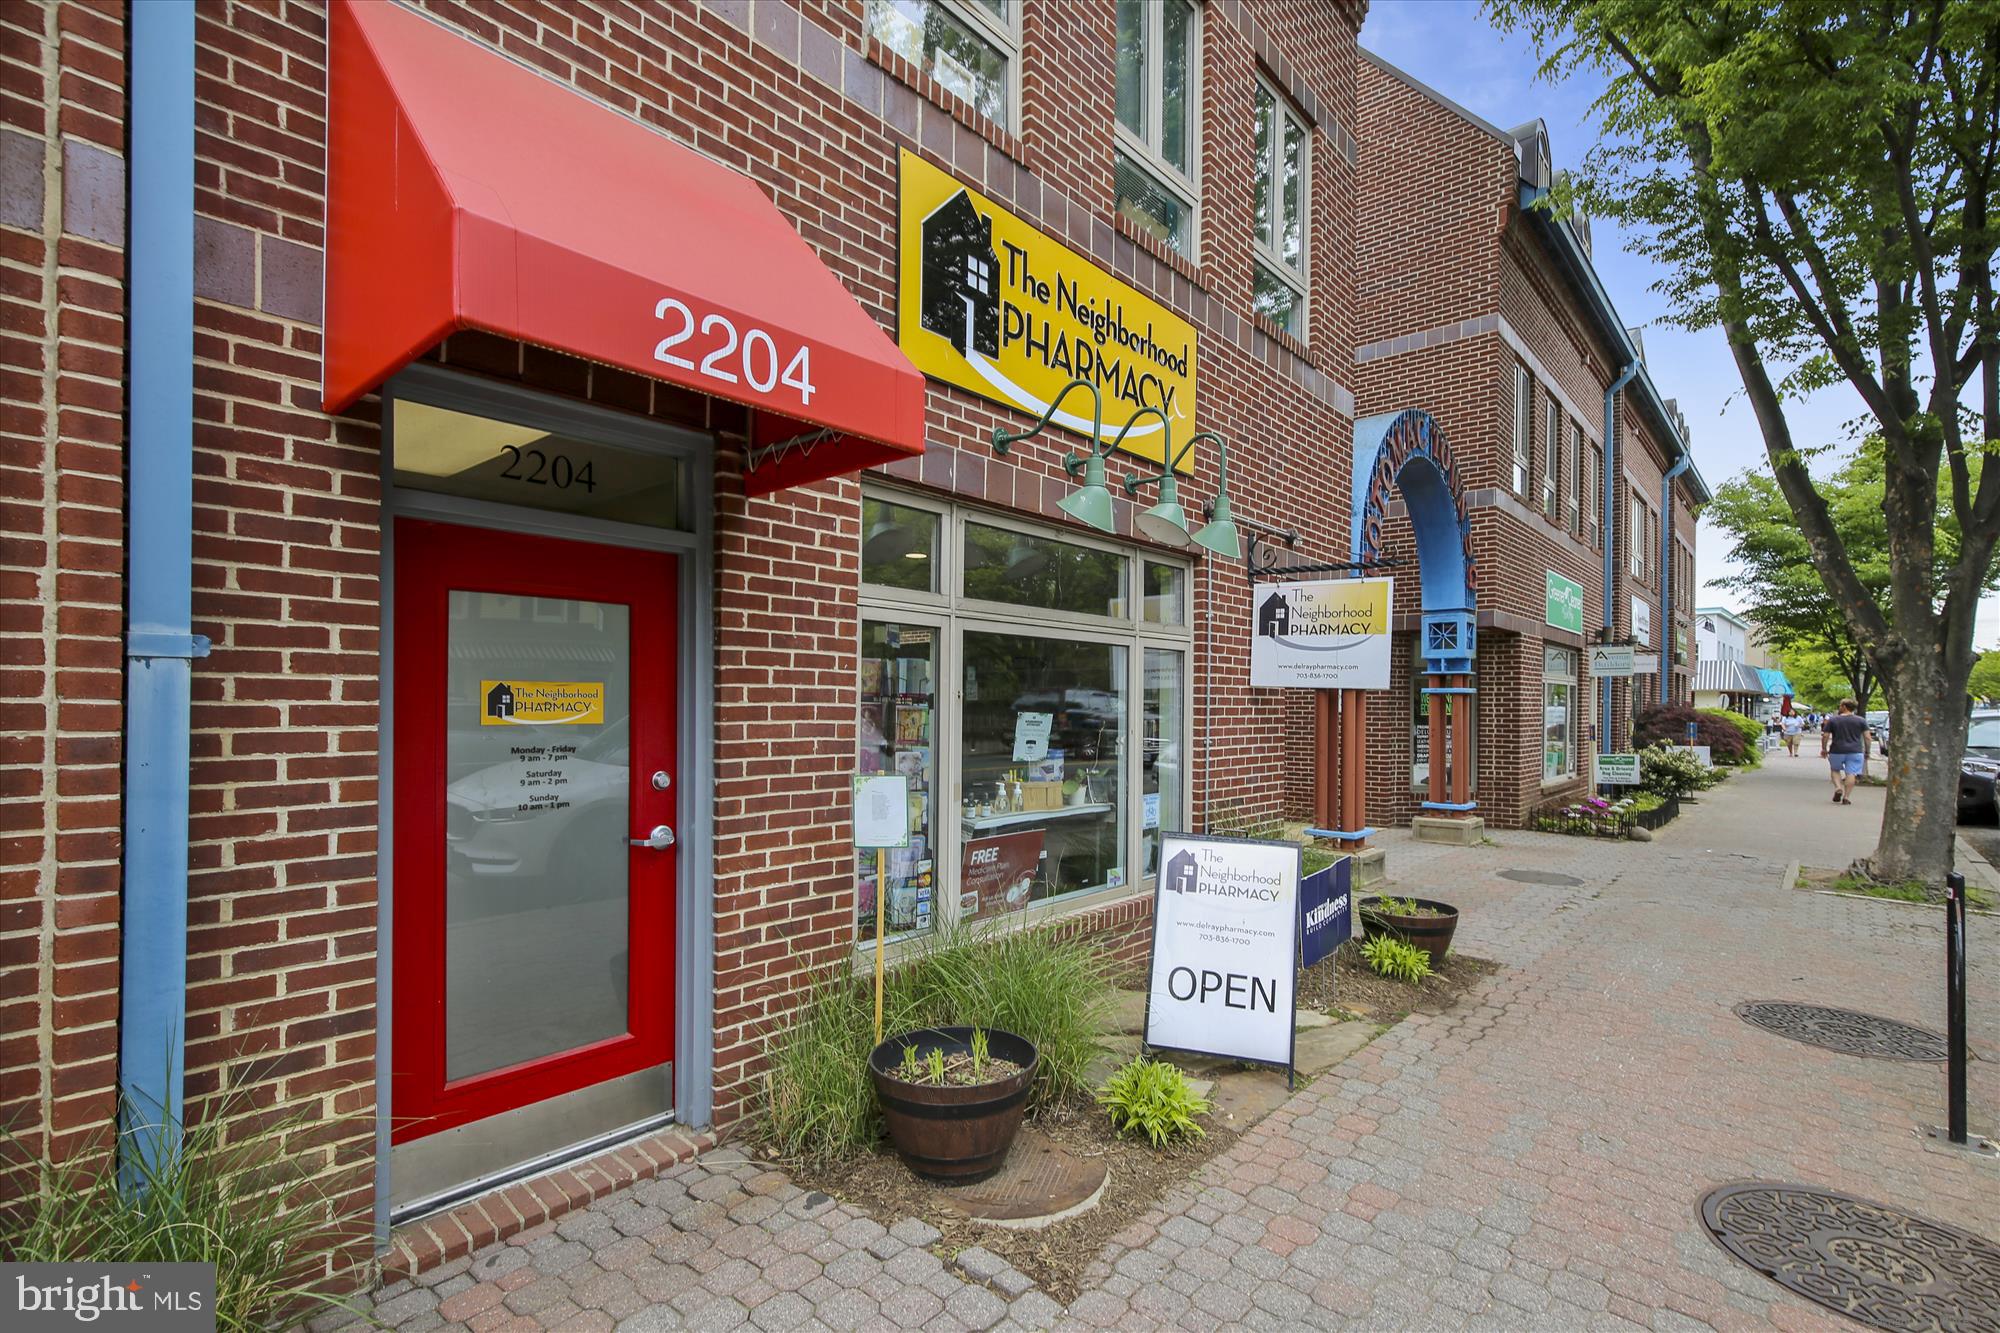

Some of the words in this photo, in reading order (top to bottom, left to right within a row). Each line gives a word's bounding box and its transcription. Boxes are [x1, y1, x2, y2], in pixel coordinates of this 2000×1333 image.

[1001, 239, 1050, 305] The
[1056, 271, 1189, 379] Neighborhood
[654, 298, 816, 405] 2204
[1002, 300, 1176, 417] PHARMACY
[500, 445, 597, 493] 2204
[1292, 588, 1314, 602] The
[1291, 602, 1373, 622] Neighborhood
[1290, 622, 1371, 636] PHARMACY
[1296, 672, 1338, 680] 703-836-1700
[515, 687, 534, 699] The
[536, 688, 599, 701] Neighborhood
[515, 701, 592, 712] PHARMACY
[511, 746, 545, 755] Monday
[552, 745, 577, 754] Friday
[520, 754, 526, 762] 9
[526, 769, 562, 778] Saturday
[520, 779, 526, 787] 9
[555, 779, 568, 787] pm
[529, 793, 559, 802] Sunday
[556, 802, 570, 810] pm
[971, 847, 999, 865] FREE
[1201, 848, 1224, 864] The
[1200, 865, 1282, 887] Neighborhood
[1199, 882, 1280, 902] PHARMACY
[1306, 893, 1348, 929] Kindness
[1176, 919, 1276, 938] www.delraypharmacy.com
[1199, 932, 1251, 946] 703-836-1700
[1168, 966, 1277, 1013] OPEN
